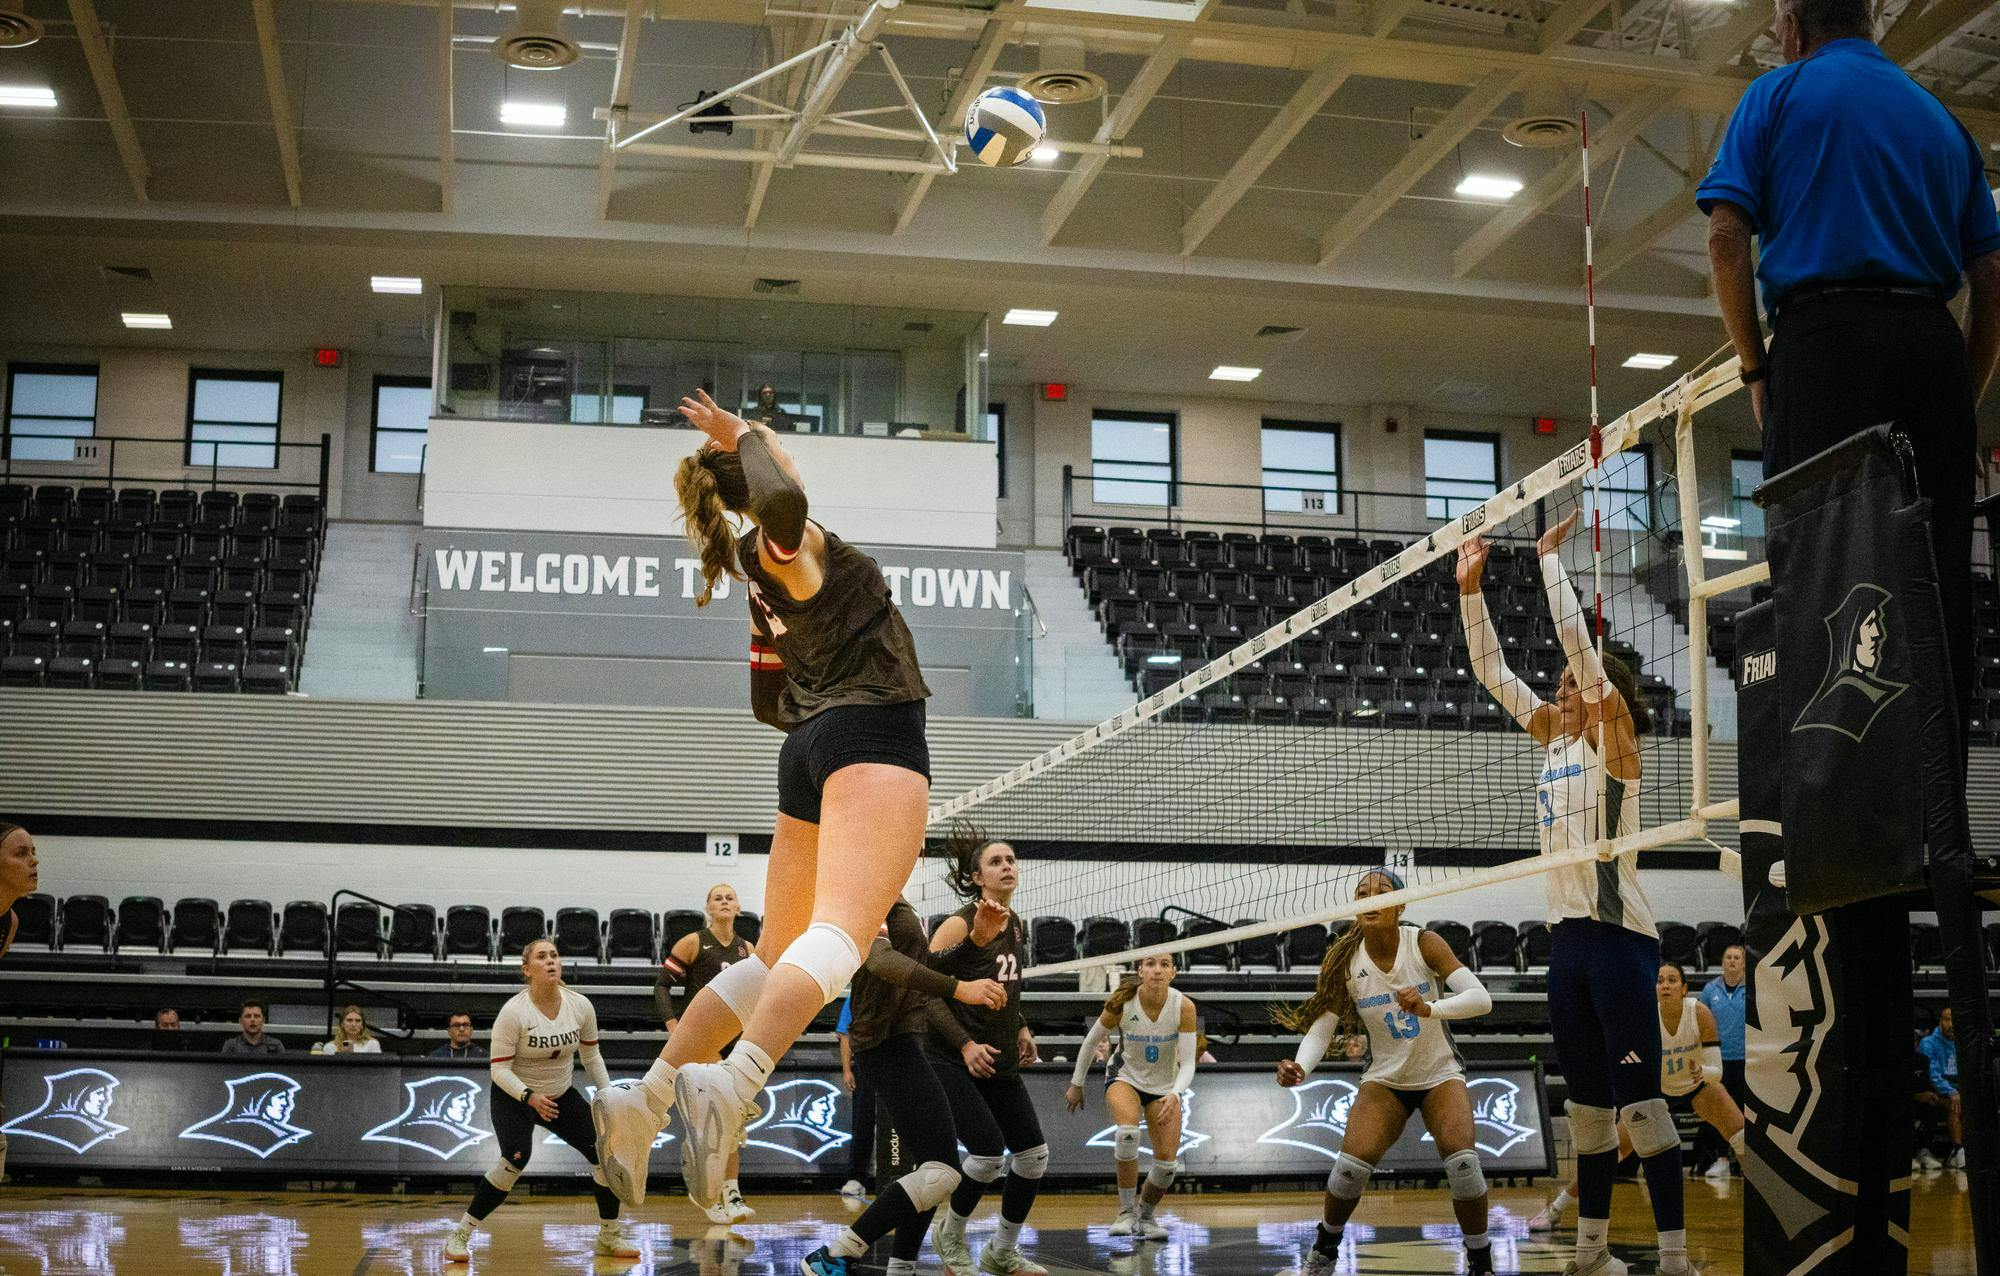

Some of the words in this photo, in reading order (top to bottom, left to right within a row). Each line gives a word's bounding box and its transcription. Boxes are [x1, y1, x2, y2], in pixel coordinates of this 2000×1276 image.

[77, 446, 97, 458] 111
[1559, 445, 1586, 477] FRIARS
[1304, 498, 1324, 510] 113
[435, 549, 660, 597] WELCOME
[1539, 790, 1556, 827] 3
[714, 842, 732, 856] 12
[1393, 854, 1408, 867] 13
[996, 953, 1018, 981] 22
[1384, 1009, 1420, 1039] 13
[528, 1028, 582, 1049] BROWN
[1667, 1057, 1684, 1076] 11
